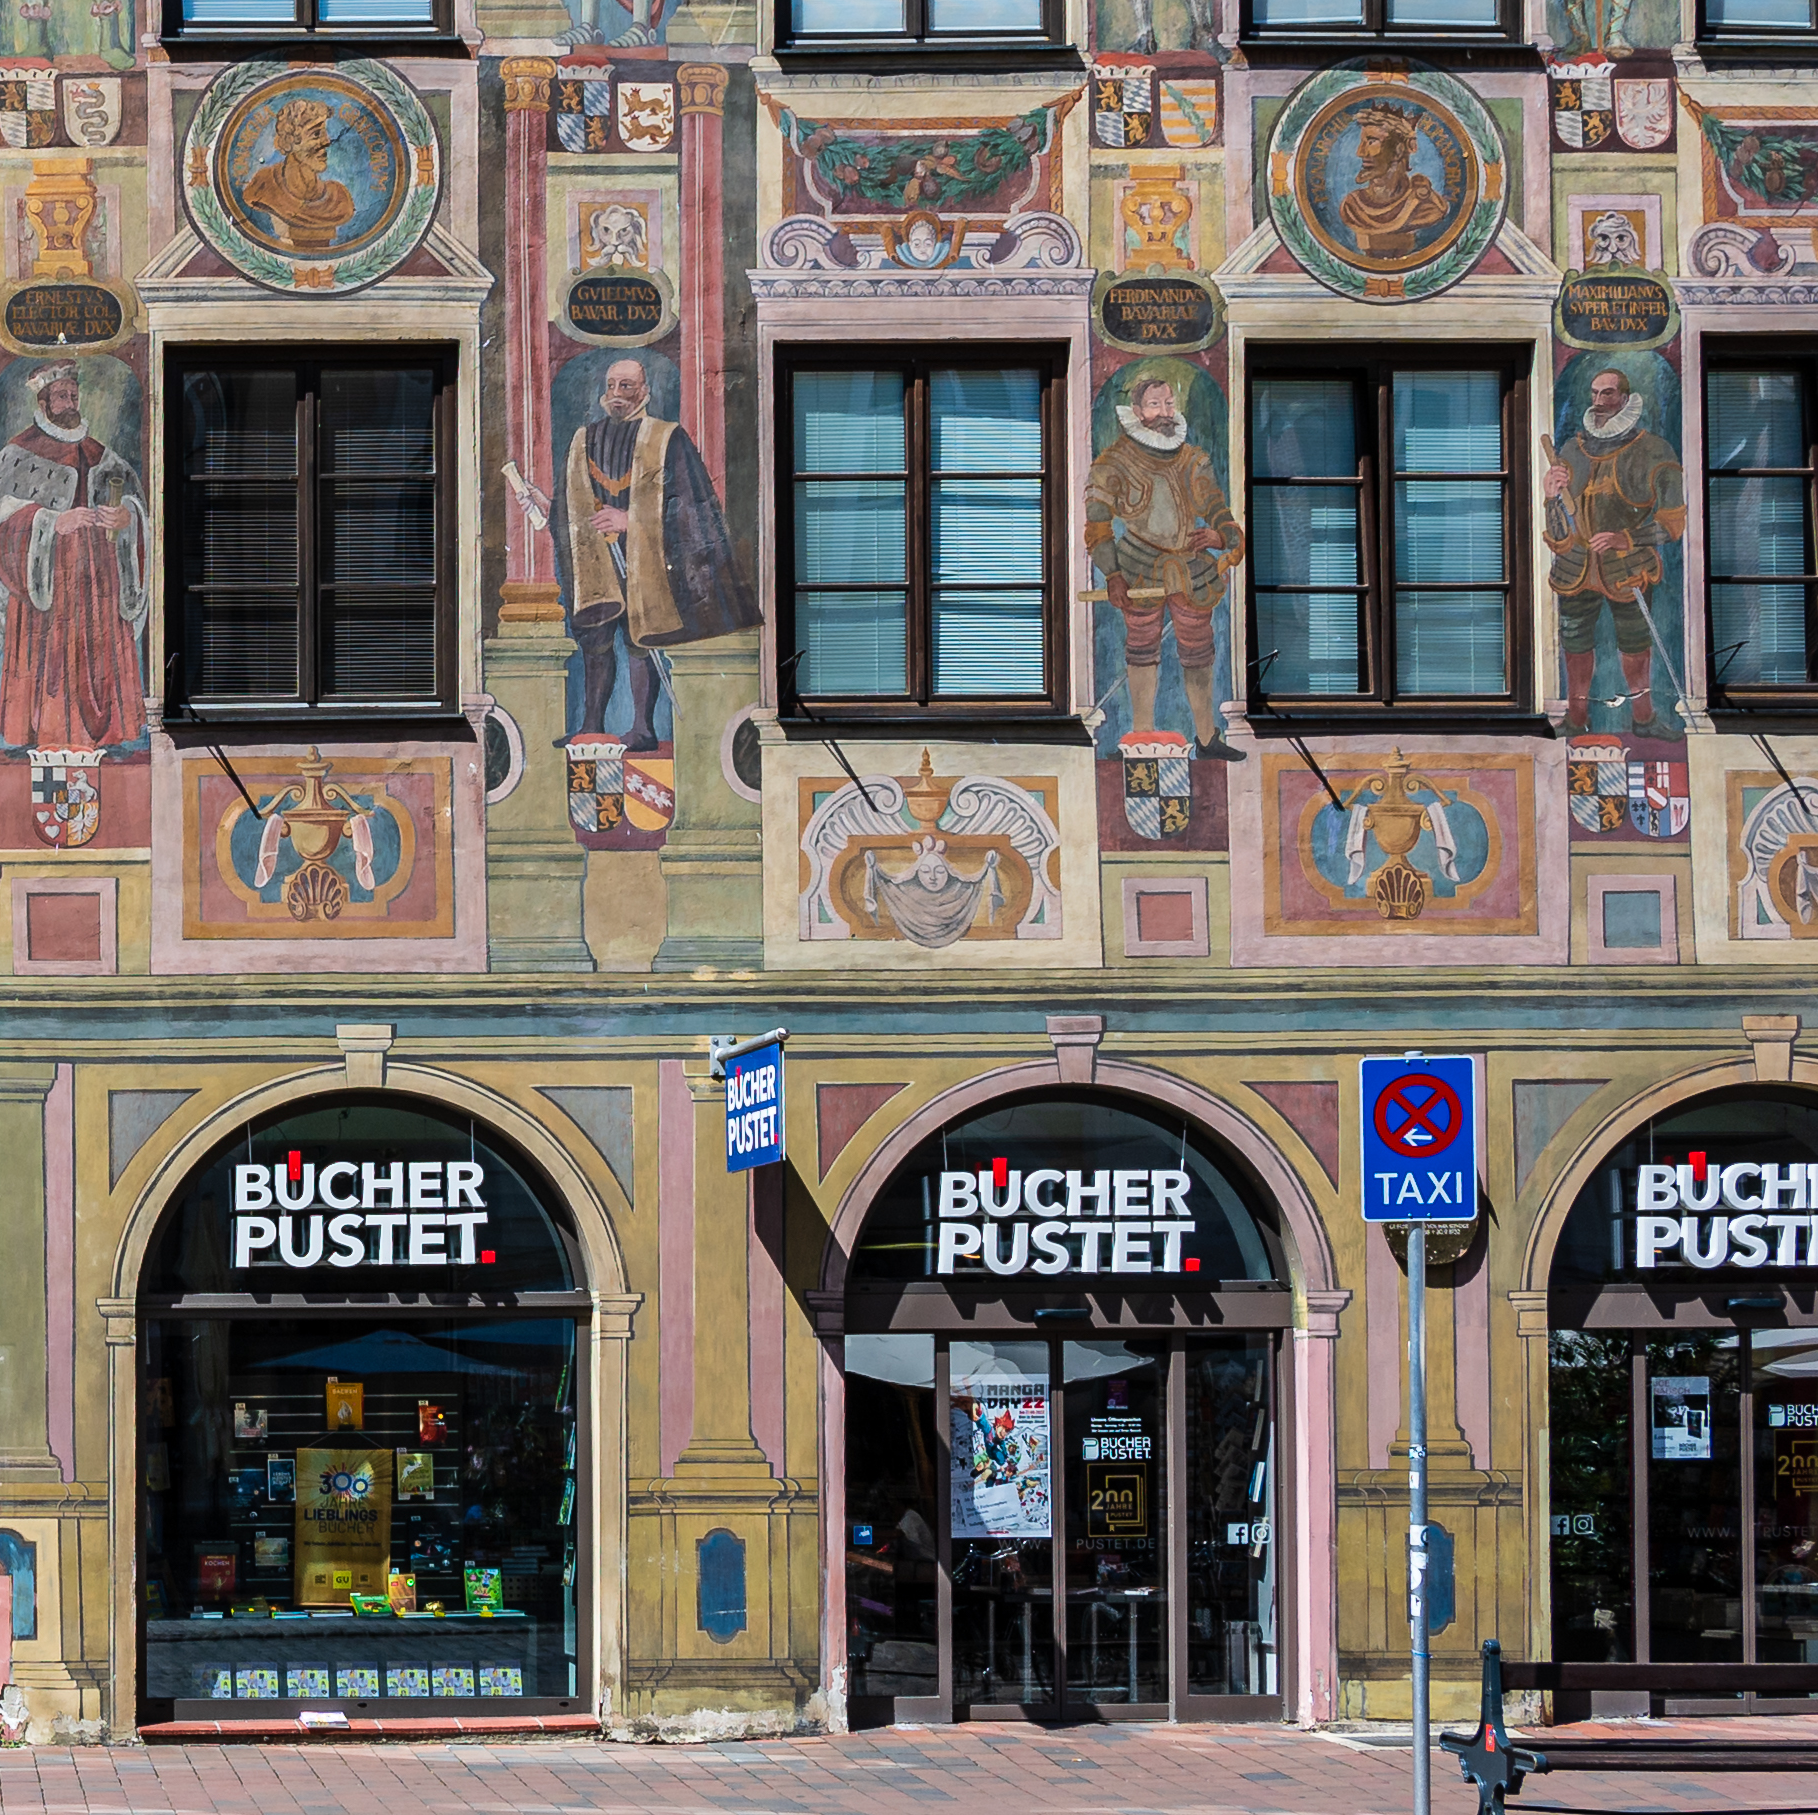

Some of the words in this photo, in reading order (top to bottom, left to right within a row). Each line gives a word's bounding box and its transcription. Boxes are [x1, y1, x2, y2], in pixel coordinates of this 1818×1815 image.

[577, 286, 656, 302] GVIELMVS
[1110, 289, 1206, 304] FERDINANDVS
[1568, 283, 1662, 299] MAXIMILIANVS
[627, 305, 660, 320] DVX
[84, 321, 116, 335] DVX
[1141, 324, 1177, 338] DVX
[1621, 317, 1648, 332] DVX
[727, 1066, 776, 1112] BÜCHER
[235, 1150, 488, 1211] BÜCHER
[939, 1157, 1192, 1217] BÜCHER
[1374, 1171, 1463, 1205] TAXI
[987, 1384, 1045, 1395] MANGA
[1100, 1436, 1152, 1448] BÜCHER
[319, 1471, 369, 1495] 300
[1106, 1502, 1133, 1510] JAHRE
[304, 1508, 378, 1522] LIEBLINGS
[318, 1521, 375, 1534] BÜCHER
